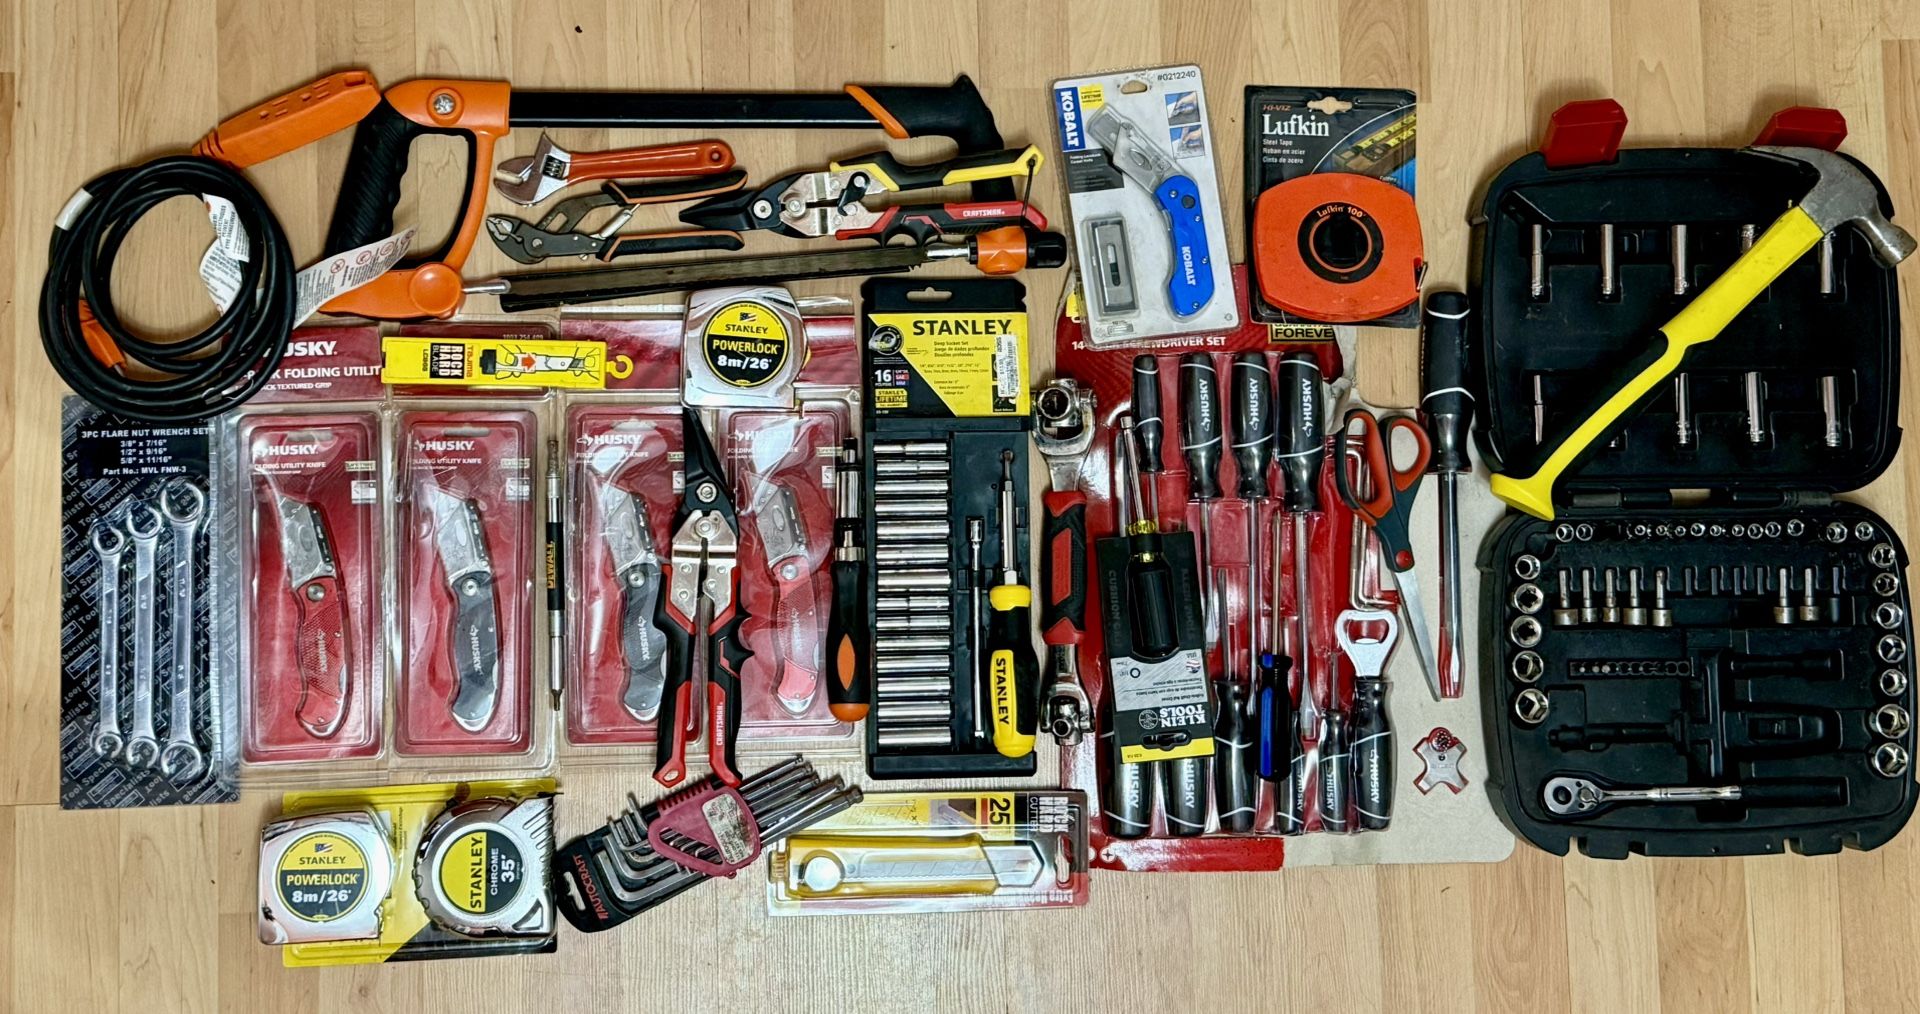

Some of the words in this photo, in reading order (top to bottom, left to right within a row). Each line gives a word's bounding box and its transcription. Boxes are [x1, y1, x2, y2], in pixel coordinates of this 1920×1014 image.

[1157, 71, 1196, 81] #0212240
[1060, 90, 1079, 147] KOBALT
[1262, 113, 1330, 137] Lufkin
[1262, 138, 1278, 146] Steel
[1279, 138, 1293, 147] Tape
[963, 209, 1001, 217] CRAFTSMAN
[1317, 205, 1344, 218] Lufkin
[1182, 246, 1196, 286] KOBALT
[725, 324, 769, 335] STANLEY
[913, 319, 1010, 336] STANLEY
[263, 341, 335, 357] USKY
[712, 339, 777, 355] POWERLOCK
[1206, 336, 1226, 346] SET
[431, 344, 439, 373] BLADE
[439, 345, 451, 376] HARD
[451, 345, 464, 377] ROCK
[284, 367, 340, 379] FOLDING
[343, 365, 381, 377] UTILIT
[875, 369, 892, 382] 16
[1199, 378, 1210, 417] HUSKY
[1249, 378, 1259, 417] HUSKY
[1303, 378, 1312, 421] HUSKY
[81, 431, 98, 439] 3PC
[101, 430, 129, 438] FLARE
[132, 429, 150, 437] NUT
[152, 428, 190, 436] WRENCH
[193, 427, 211, 435] SET
[146, 439, 167, 447] 7/16"
[594, 434, 640, 444] HUSKY
[269, 445, 317, 456] HUSKY
[425, 441, 474, 451] HUSKY
[141, 466, 159, 474] MVL
[471, 636, 482, 671] HUSKY
[639, 628, 650, 660] HUSKY
[996, 657, 1010, 725] STANLEY
[1160, 704, 1205, 718] TOOLS
[1161, 714, 1206, 728] KLEIN
[715, 705, 723, 746] CRAFTSMAN
[1185, 764, 1195, 808] HUSKY
[1326, 776, 1335, 811] HUSKY
[1370, 763, 1379, 804] HUSKY
[989, 798, 1011, 825] 25
[1030, 796, 1038, 832] CUTTER
[1039, 797, 1054, 832] HARD
[1054, 797, 1069, 832] ROCK
[299, 856, 347, 865] STANLEY
[470, 837, 483, 909] STANLEY
[490, 847, 499, 896] CHROME
[286, 874, 358, 886] POWERLOCK
[573, 854, 607, 915] AUTOCRAFT
